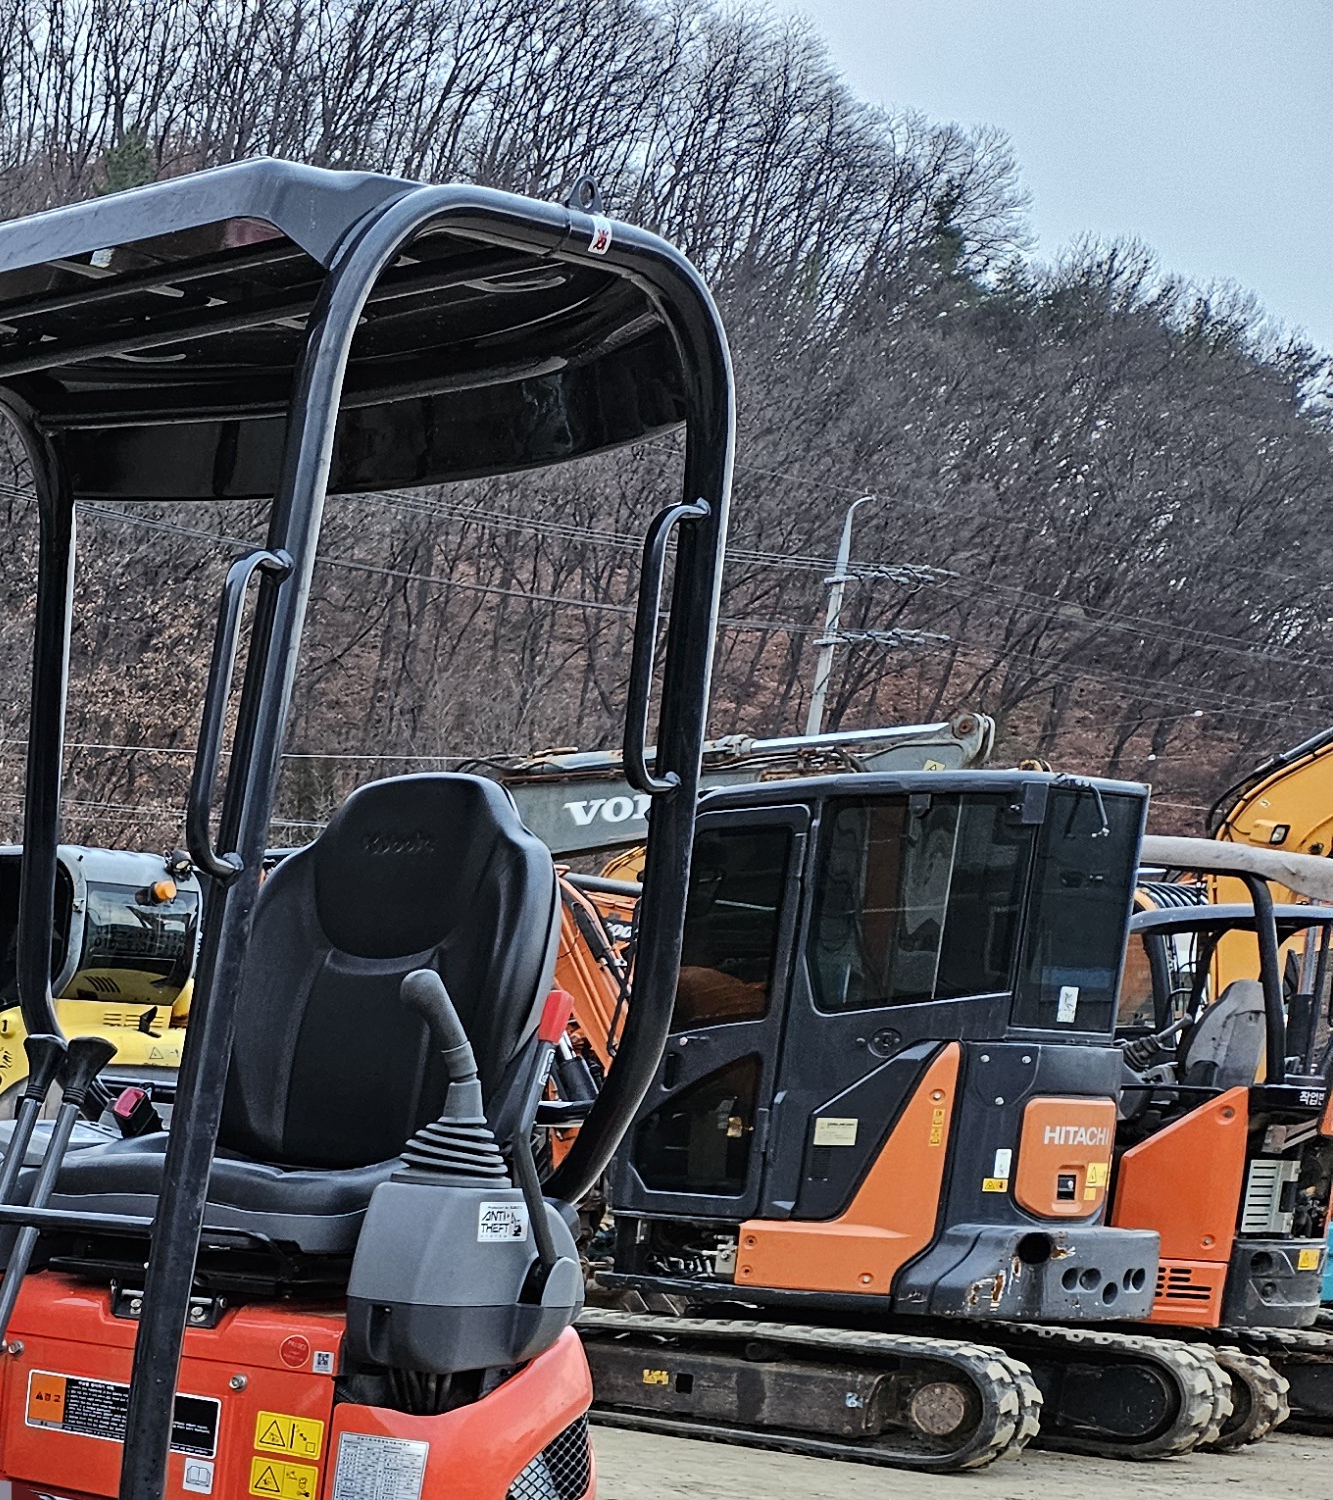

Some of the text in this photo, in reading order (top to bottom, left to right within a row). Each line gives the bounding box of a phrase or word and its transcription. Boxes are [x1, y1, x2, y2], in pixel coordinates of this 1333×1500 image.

[1043, 1125, 1110, 1146] HITACHI
[481, 1210, 506, 1222] ANTI
[481, 1222, 510, 1233] THEFT
